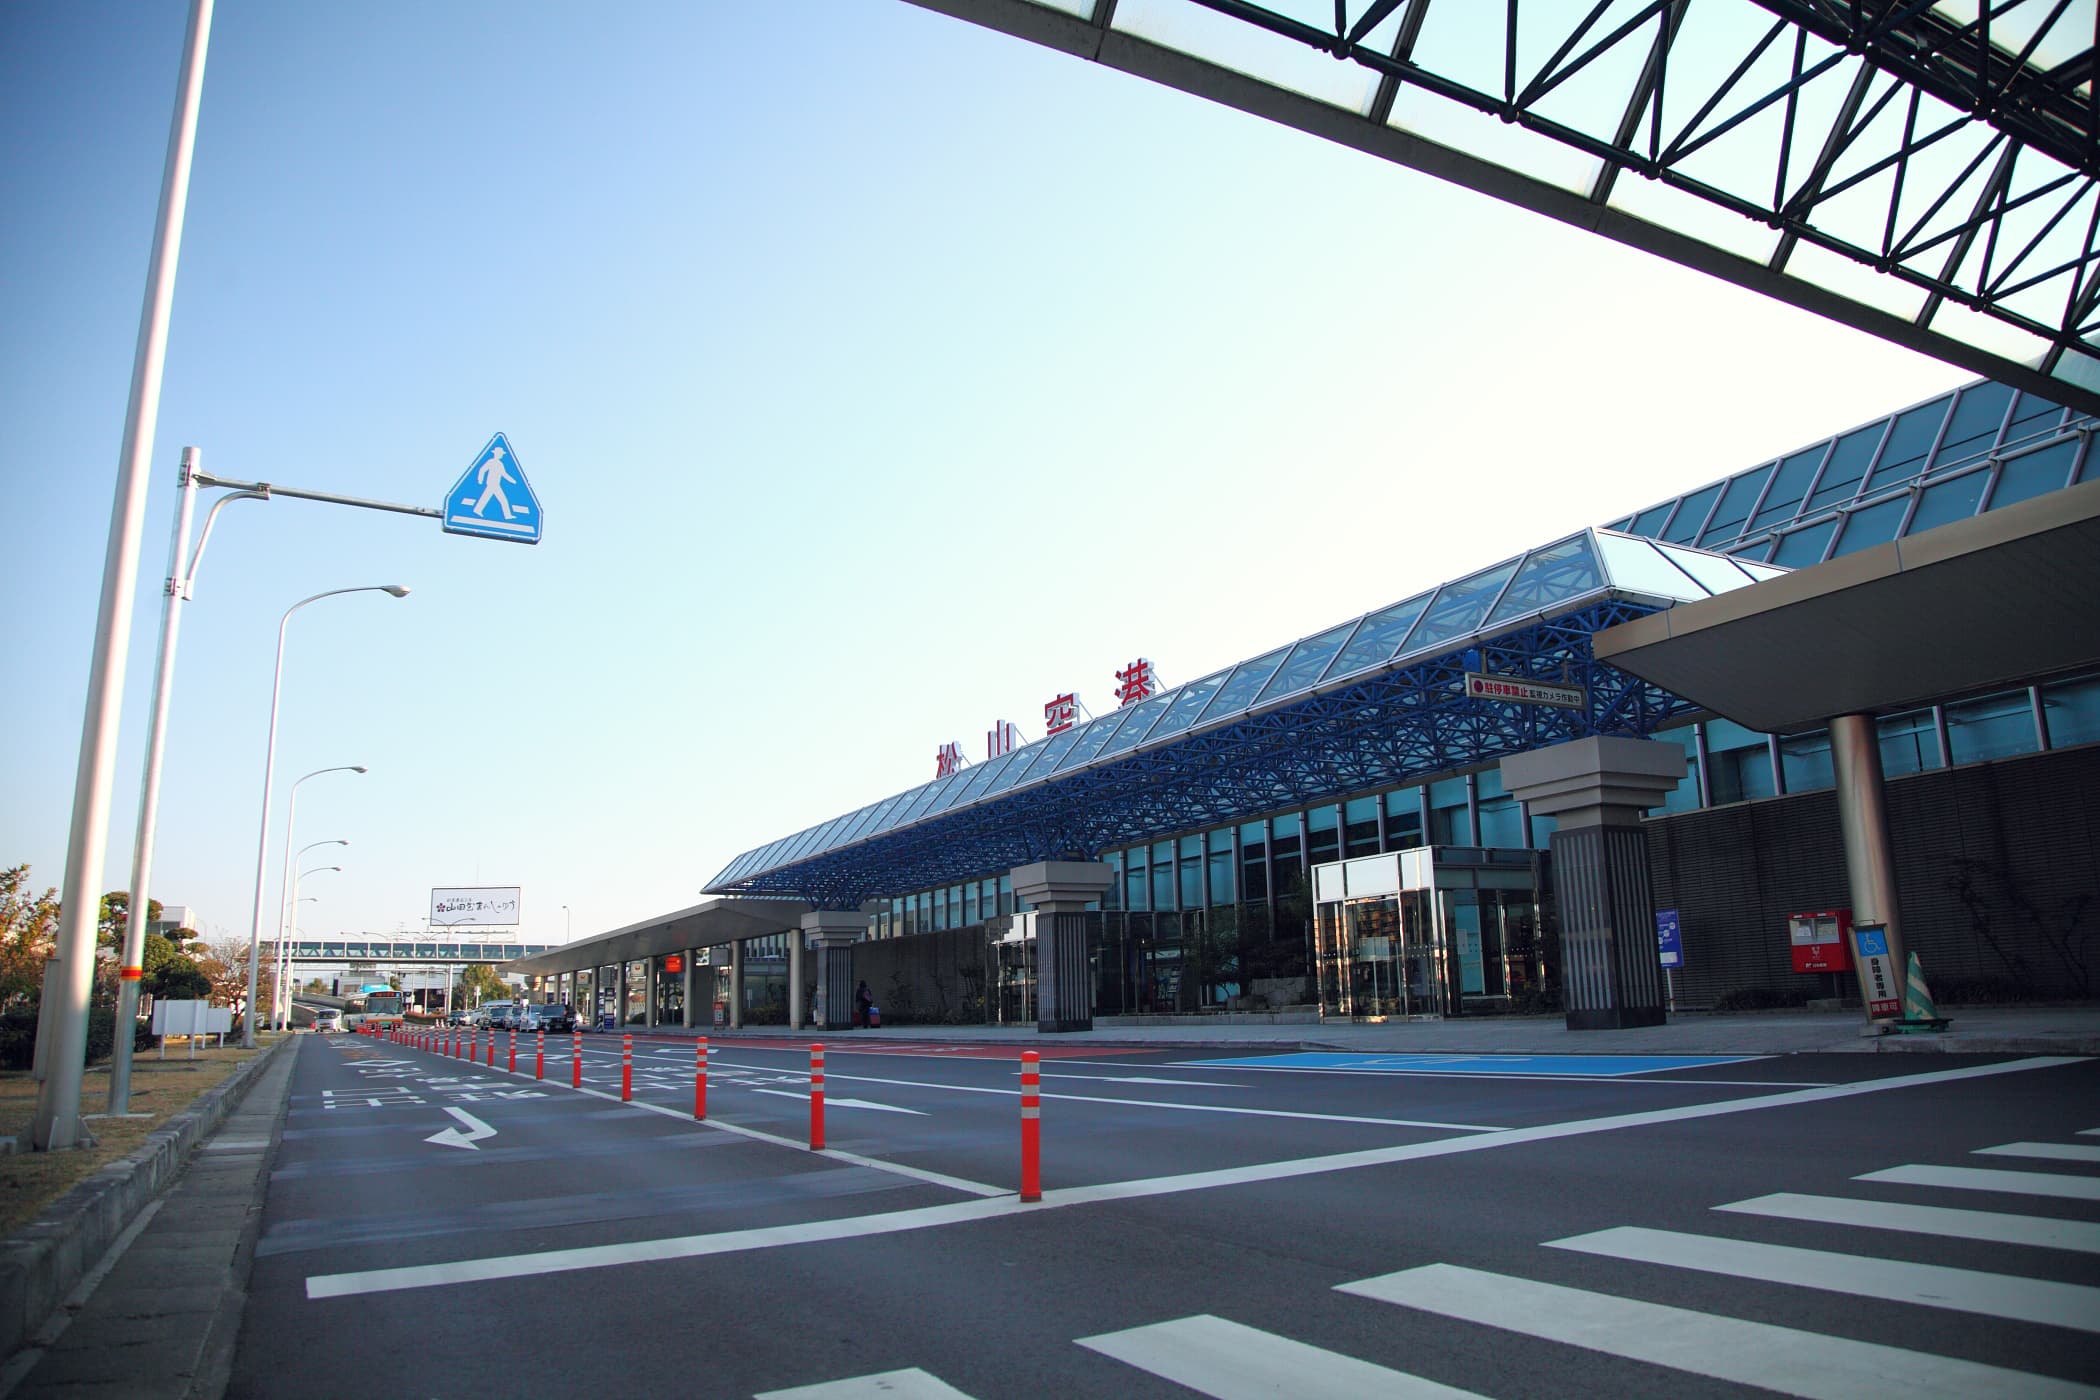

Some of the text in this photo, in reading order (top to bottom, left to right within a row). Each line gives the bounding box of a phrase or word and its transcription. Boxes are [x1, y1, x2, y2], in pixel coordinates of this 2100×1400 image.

[936, 657, 1152, 779] 松山空港
[1484, 682, 1528, 698] 駐停車禁止
